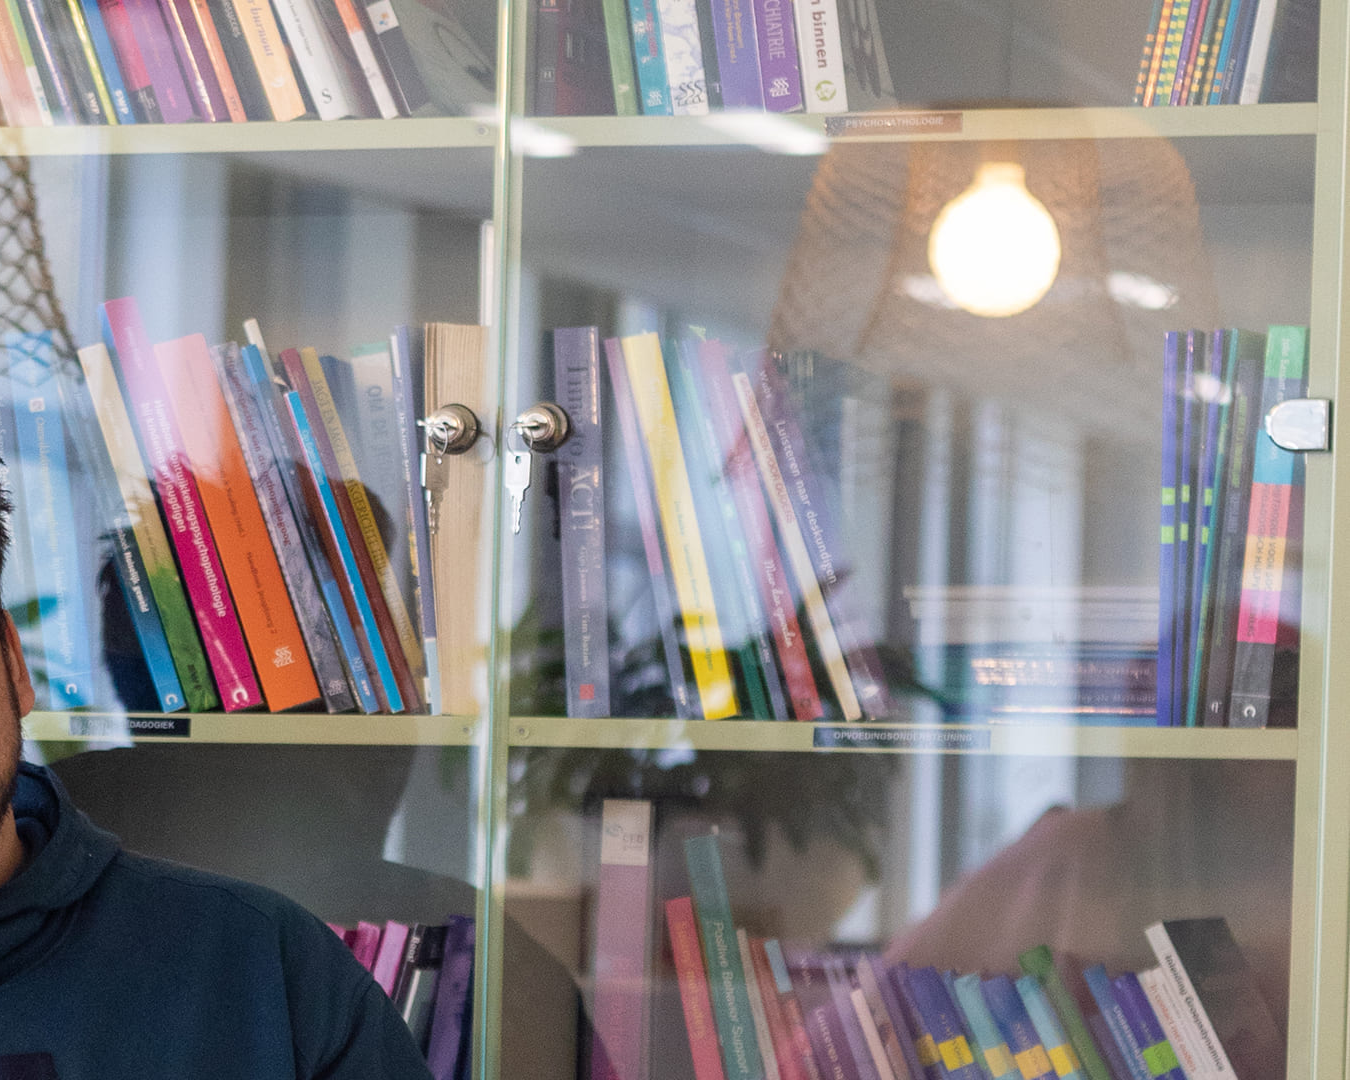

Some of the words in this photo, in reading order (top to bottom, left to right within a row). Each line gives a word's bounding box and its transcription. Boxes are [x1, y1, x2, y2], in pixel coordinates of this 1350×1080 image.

[249, 7, 275, 58] burnout
[812, 11, 830, 69] binnen
[115, 90, 130, 115] SWP
[845, 115, 944, 128] PSYCHOPATHOLOGIE
[153, 399, 180, 452] Handboek
[169, 456, 228, 619] ontwikkelingspsychopathologie
[161, 481, 188, 534] jeugdigen
[263, 470, 293, 548] orthopedagoog
[569, 463, 596, 531] ACT!
[775, 419, 802, 478] Luisteren
[794, 479, 813, 508] naar
[805, 510, 839, 585] deskundigen
[65, 683, 78, 695] C
[165, 693, 180, 707] C
[231, 686, 251, 705] C
[1243, 705, 1257, 719] C
[712, 921, 730, 968] Positive
[721, 971, 741, 1022] Behavior
[731, 1025, 750, 1074] Support
[1163, 954, 1189, 998] Inleiding
[814, 1008, 840, 1063] Luisteren
